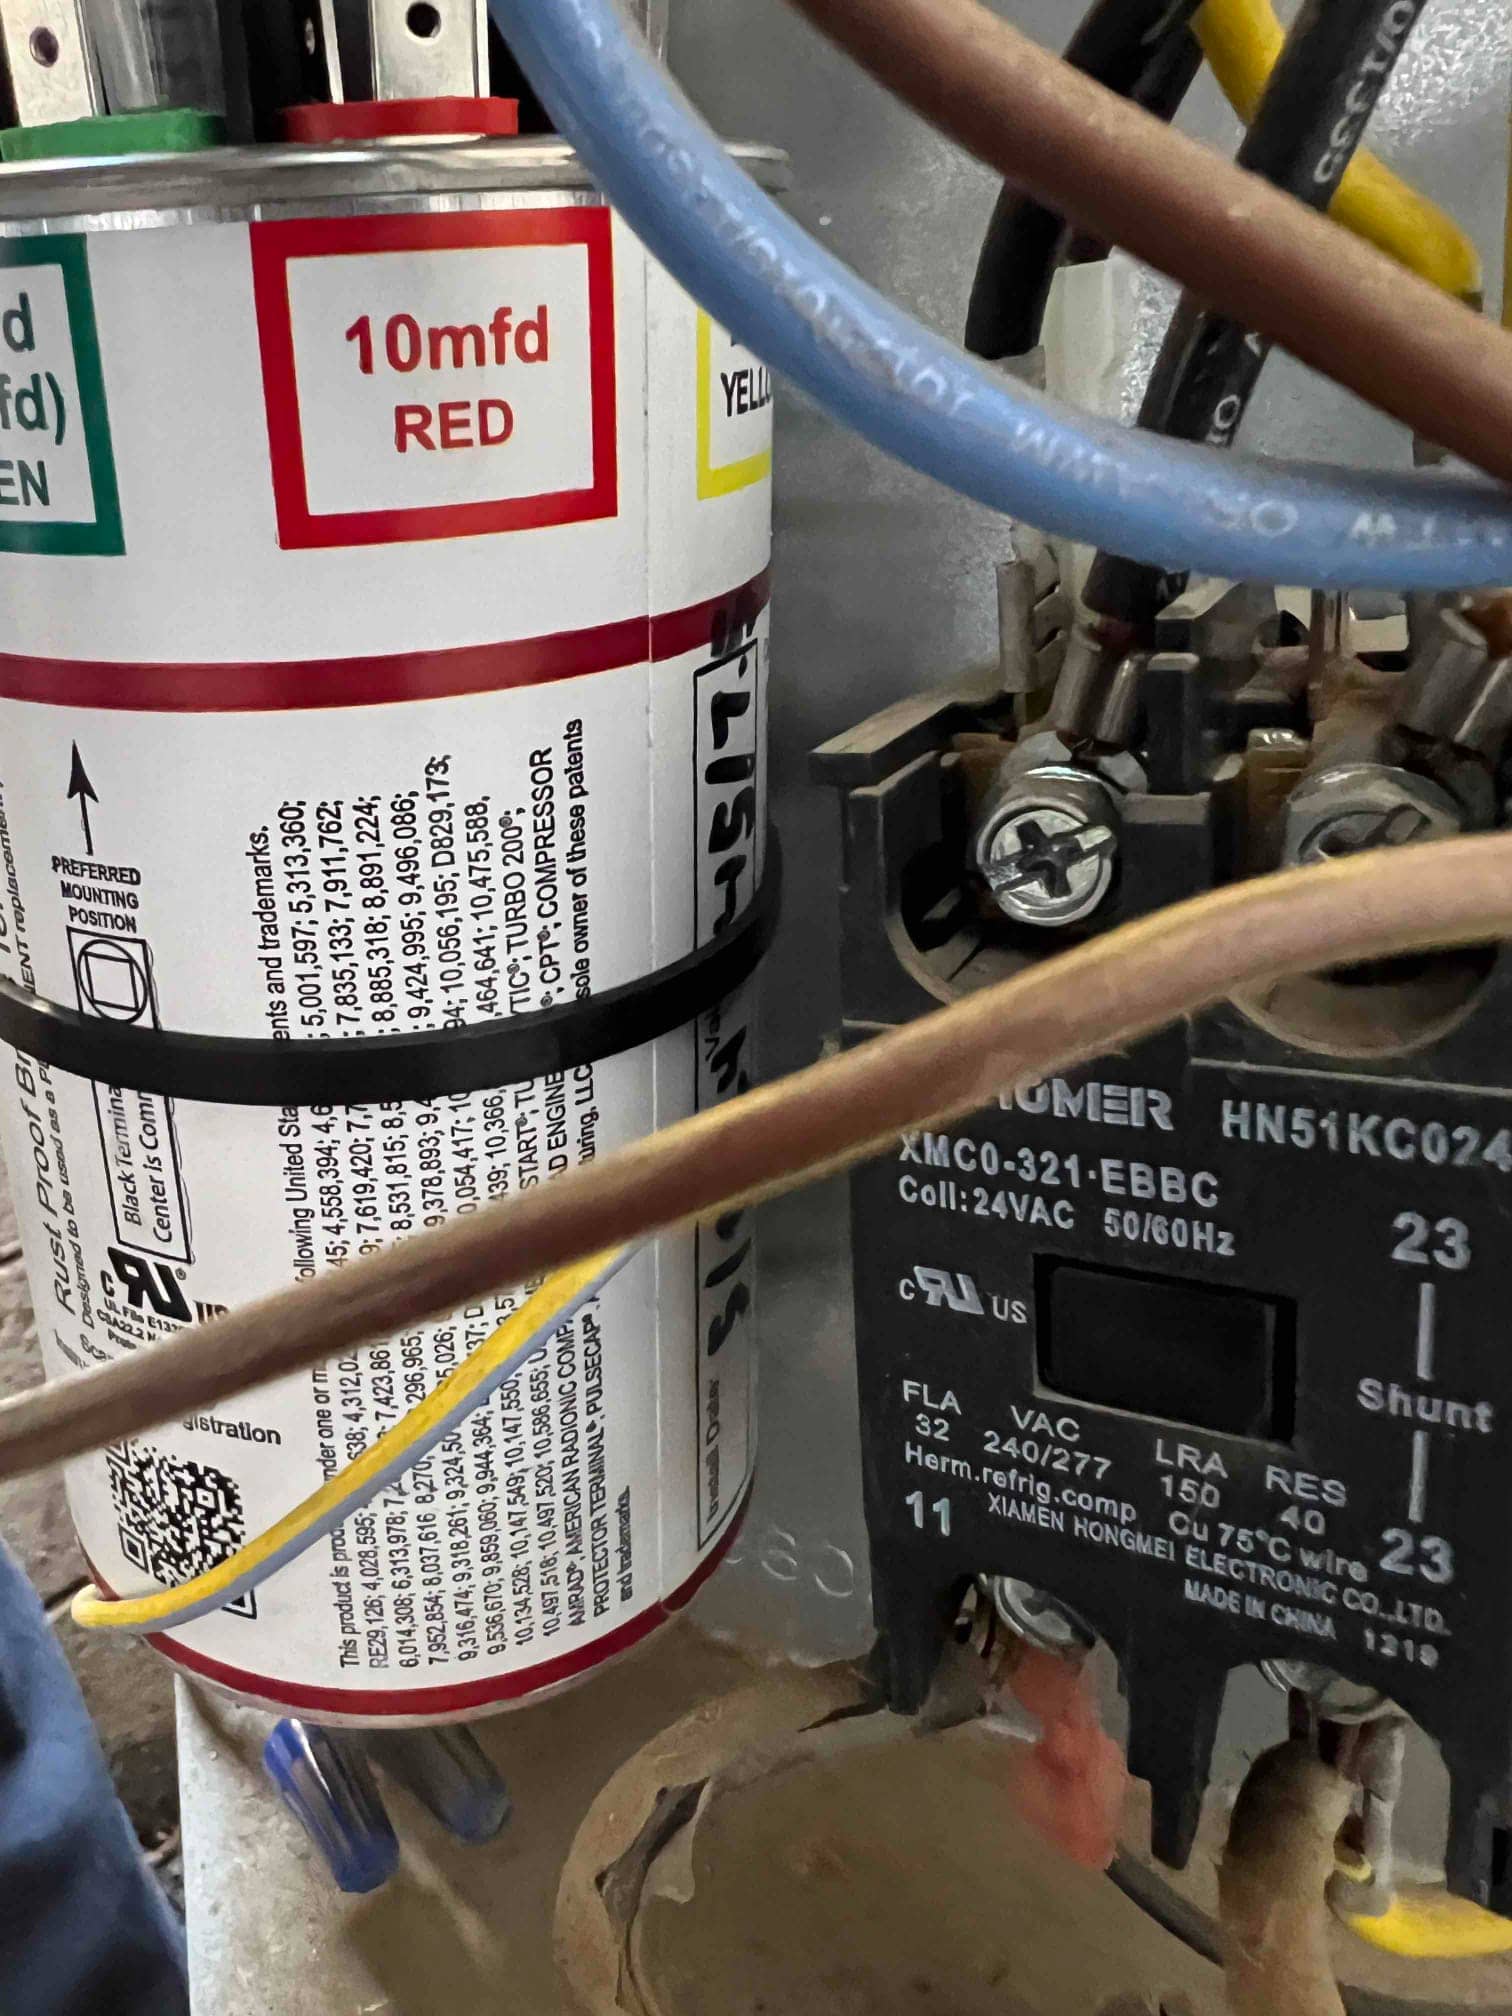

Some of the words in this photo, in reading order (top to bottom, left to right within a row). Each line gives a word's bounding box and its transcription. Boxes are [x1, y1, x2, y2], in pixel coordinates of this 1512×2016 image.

[345, 304, 550, 375] 10mfd
[393, 399, 515, 454] RED
[721, 366, 770, 417] YELL
[562, 718, 591, 799] patents
[424, 754, 456, 867] D829,173;
[528, 747, 560, 919] COMPRESSOR
[565, 804, 588, 864] these
[51, 855, 142, 885] PREFERRED
[277, 800, 315, 913] 5,313,360;
[315, 800, 352, 912] 7,911,762;
[352, 796, 390, 909] 8,891,224;
[390, 790, 425, 905] 9,496,086;
[565, 867, 588, 888] of
[60, 880, 139, 910] MOUNTING
[68, 904, 137, 934] POSITION
[245, 825, 281, 950] trademarks.
[502, 872, 529, 954] TURBO
[569, 893, 590, 953] owner
[364, 915, 397, 1022] 8,885,318;
[400, 911, 433, 1019] 9,424,995;
[433, 872, 466, 994] 10,056,195;
[257, 956, 286, 994] and
[291, 919, 328, 1027] 5,001,597;
[327, 917, 361, 1025] 7,835,133;
[472, 926, 502, 1016] ,464,641;
[569, 959, 592, 998] sole
[266, 1000, 290, 1040] ents
[108, 1083, 136, 1168] Termina
[138, 1090, 157, 1147] Com
[277, 1105, 300, 1138] Sta
[483, 1089, 509, 1158] 10,366,
[1222, 1099, 1512, 1173] HN51KC024
[20, 1098, 58, 1217] Proof
[142, 1157, 163, 1177] is
[278, 1143, 308, 1202] United
[314, 1139, 349, 1235] 4,558,394;
[348, 1137, 382, 1234] 7,619,420;
[383, 1134, 414, 1230] 8,531,815;
[418, 1130, 447, 1226] 9,378,893;
[451, 1117, 480, 1214] 0,054,417;
[115, 1170, 143, 1227] Black
[150, 1179, 173, 1244] Center
[1104, 1207, 1236, 1256] 50/60Hz
[43, 1220, 75, 1315] Rust
[1391, 1211, 1471, 1270] 23
[369, 1350, 399, 1421] 7,423,86
[399, 1331, 429, 1403] 296,965;
[556, 1324, 576, 1378] COMP
[313, 1387, 330, 1404] or
[316, 1409, 334, 1438] one
[529, 1363, 554, 1458] 10,586,655;
[557, 1381, 580, 1467] RADIONIC
[902, 1379, 962, 1416] FLA
[915, 1413, 950, 1442] 32
[1010, 1405, 1081, 1443] VAC
[1357, 1377, 1494, 1433] Shunt
[316, 1442, 337, 1481] nder
[412, 1456, 438, 1504] 8,270,
[442, 1432, 469, 1500] 9,324,50
[470, 1410, 496, 1494] 9,944,364;
[983, 1430, 1112, 1480] 240/277
[1155, 1439, 1228, 1479] LRA
[1265, 1464, 1347, 1508] RES
[505, 1467, 532, 1559] 10,147,549;
[534, 1460, 559, 1550] 10,497,520;
[560, 1468, 583, 1555] AMERICAN
[906, 1490, 951, 1537] 11
[1160, 1474, 1220, 1508] 150
[1280, 1505, 1326, 1536] 40
[329, 1566, 350, 1578] is
[354, 1512, 384, 1591] 4,028,595;
[385, 1510, 413, 1589] 6,313,978;
[445, 1502, 475, 1582] 9,318,261;
[477, 1496, 503, 1577] 9,859,060;
[590, 1516, 611, 1617] PROTECTOR
[987, 1492, 1065, 1533] XIAMEN
[1073, 1515, 1175, 1562] HONGMEI
[1185, 1544, 1338, 1606] ELECTRONIC
[1168, 1510, 1209, 1542] Cu
[1218, 1522, 1292, 1563] 75°C
[1299, 1547, 1368, 1583] wire
[1380, 1527, 1454, 1584] 23
[331, 1581, 361, 1635] product
[393, 1592, 421, 1668] 6,014,308;
[423, 1589, 450, 1665] 7,952,854;
[452, 1583, 480, 1661] 9,316,474;
[483, 1577, 508, 1655] 9,536,670;
[511, 1560, 536, 1646] 10,134,528;
[539, 1551, 563, 1637] 10,497,518;
[1184, 1578, 1241, 1615] MADE
[1244, 1592, 1268, 1621] IN
[1270, 1602, 1337, 1640] CHINA
[338, 1639, 360, 1668] This
[363, 1595, 390, 1668] RE29,126;
